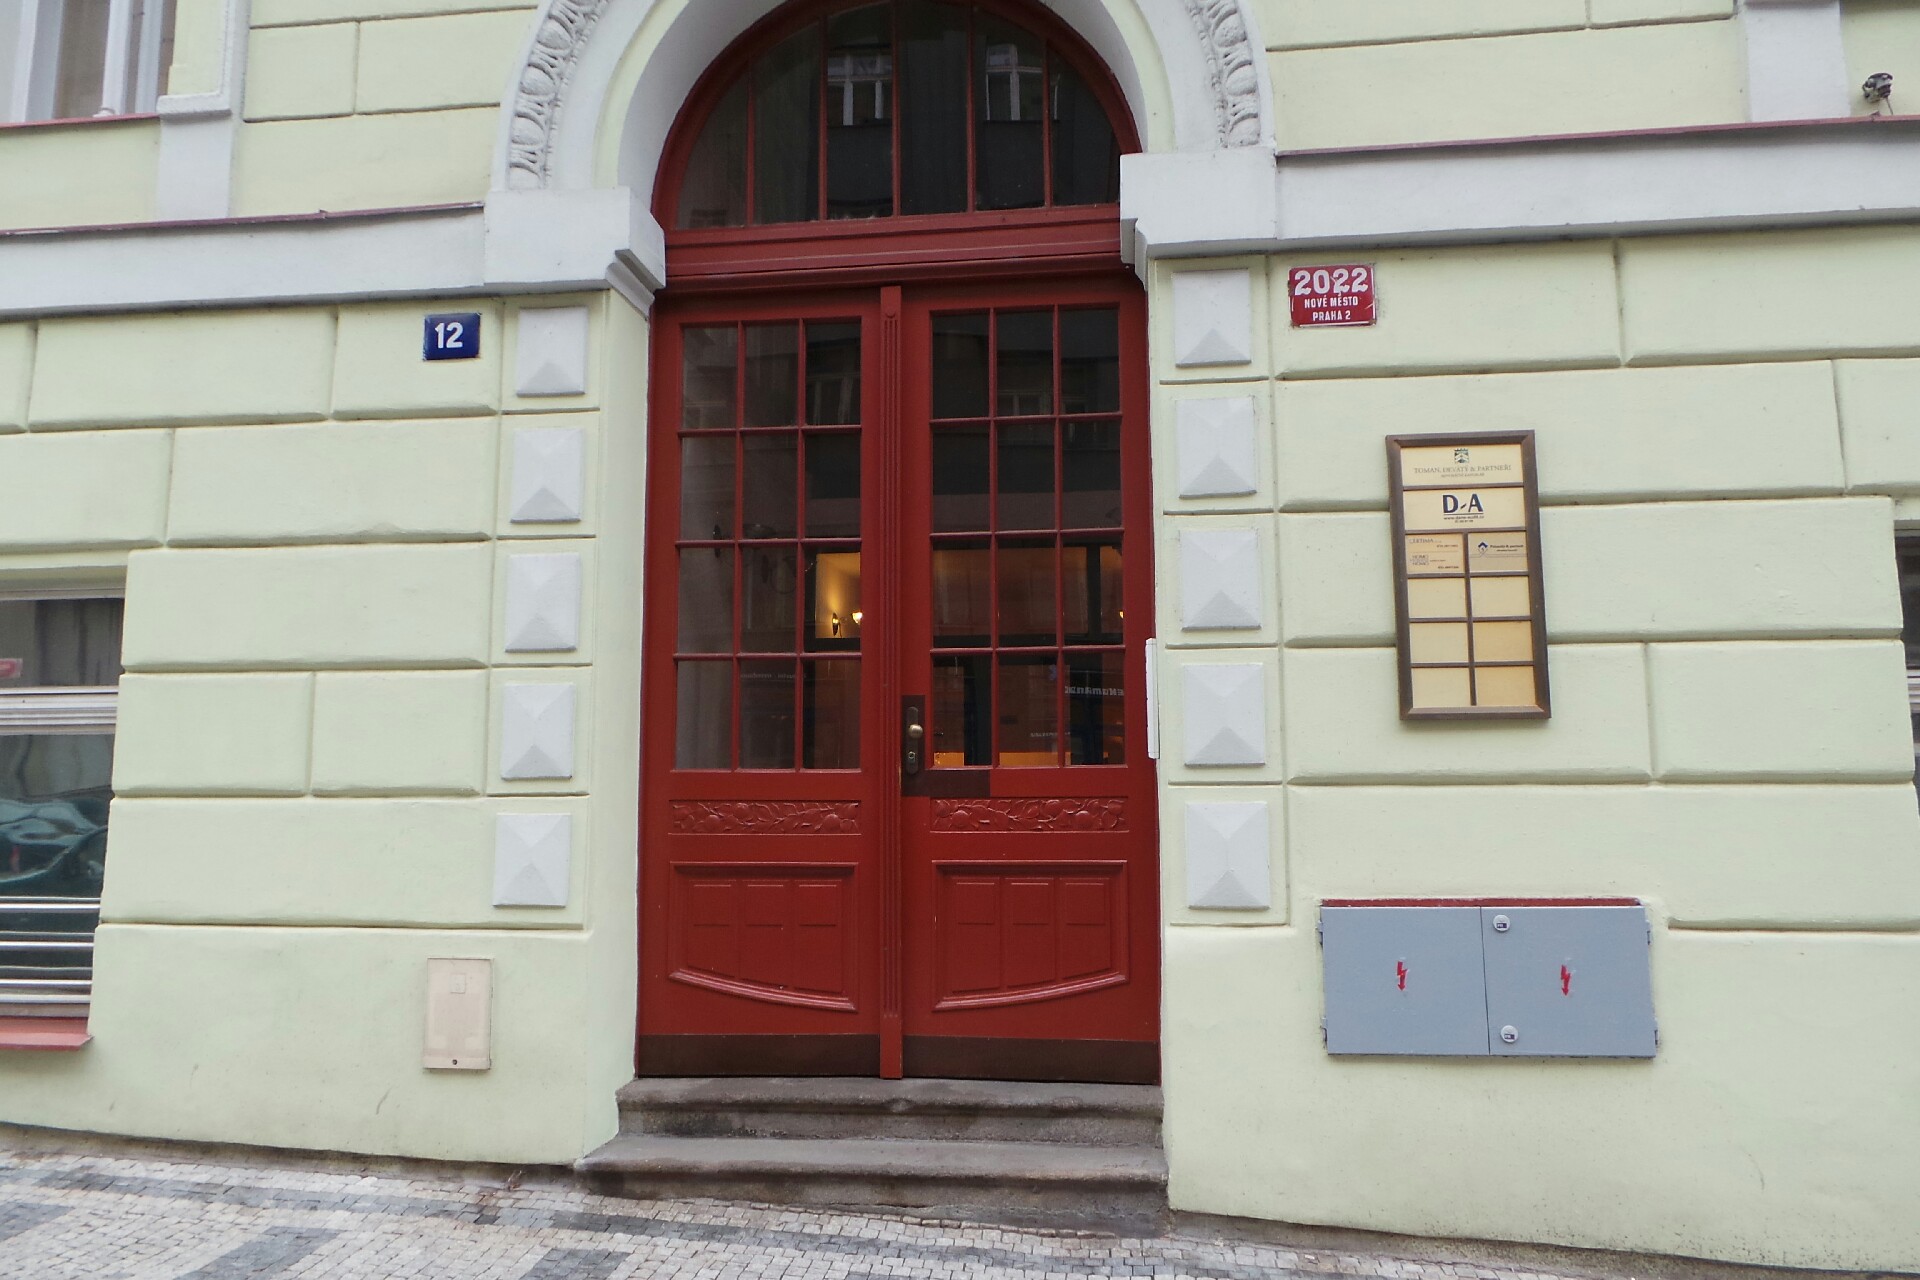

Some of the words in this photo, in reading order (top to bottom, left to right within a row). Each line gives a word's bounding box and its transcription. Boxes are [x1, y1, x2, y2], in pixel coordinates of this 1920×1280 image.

[1294, 267, 1369, 296] 2022
[1304, 295, 1328, 308] NOVÉ
[1312, 310, 1343, 321] PRAHA
[1345, 310, 1351, 320] 2
[434, 321, 464, 349] 12
